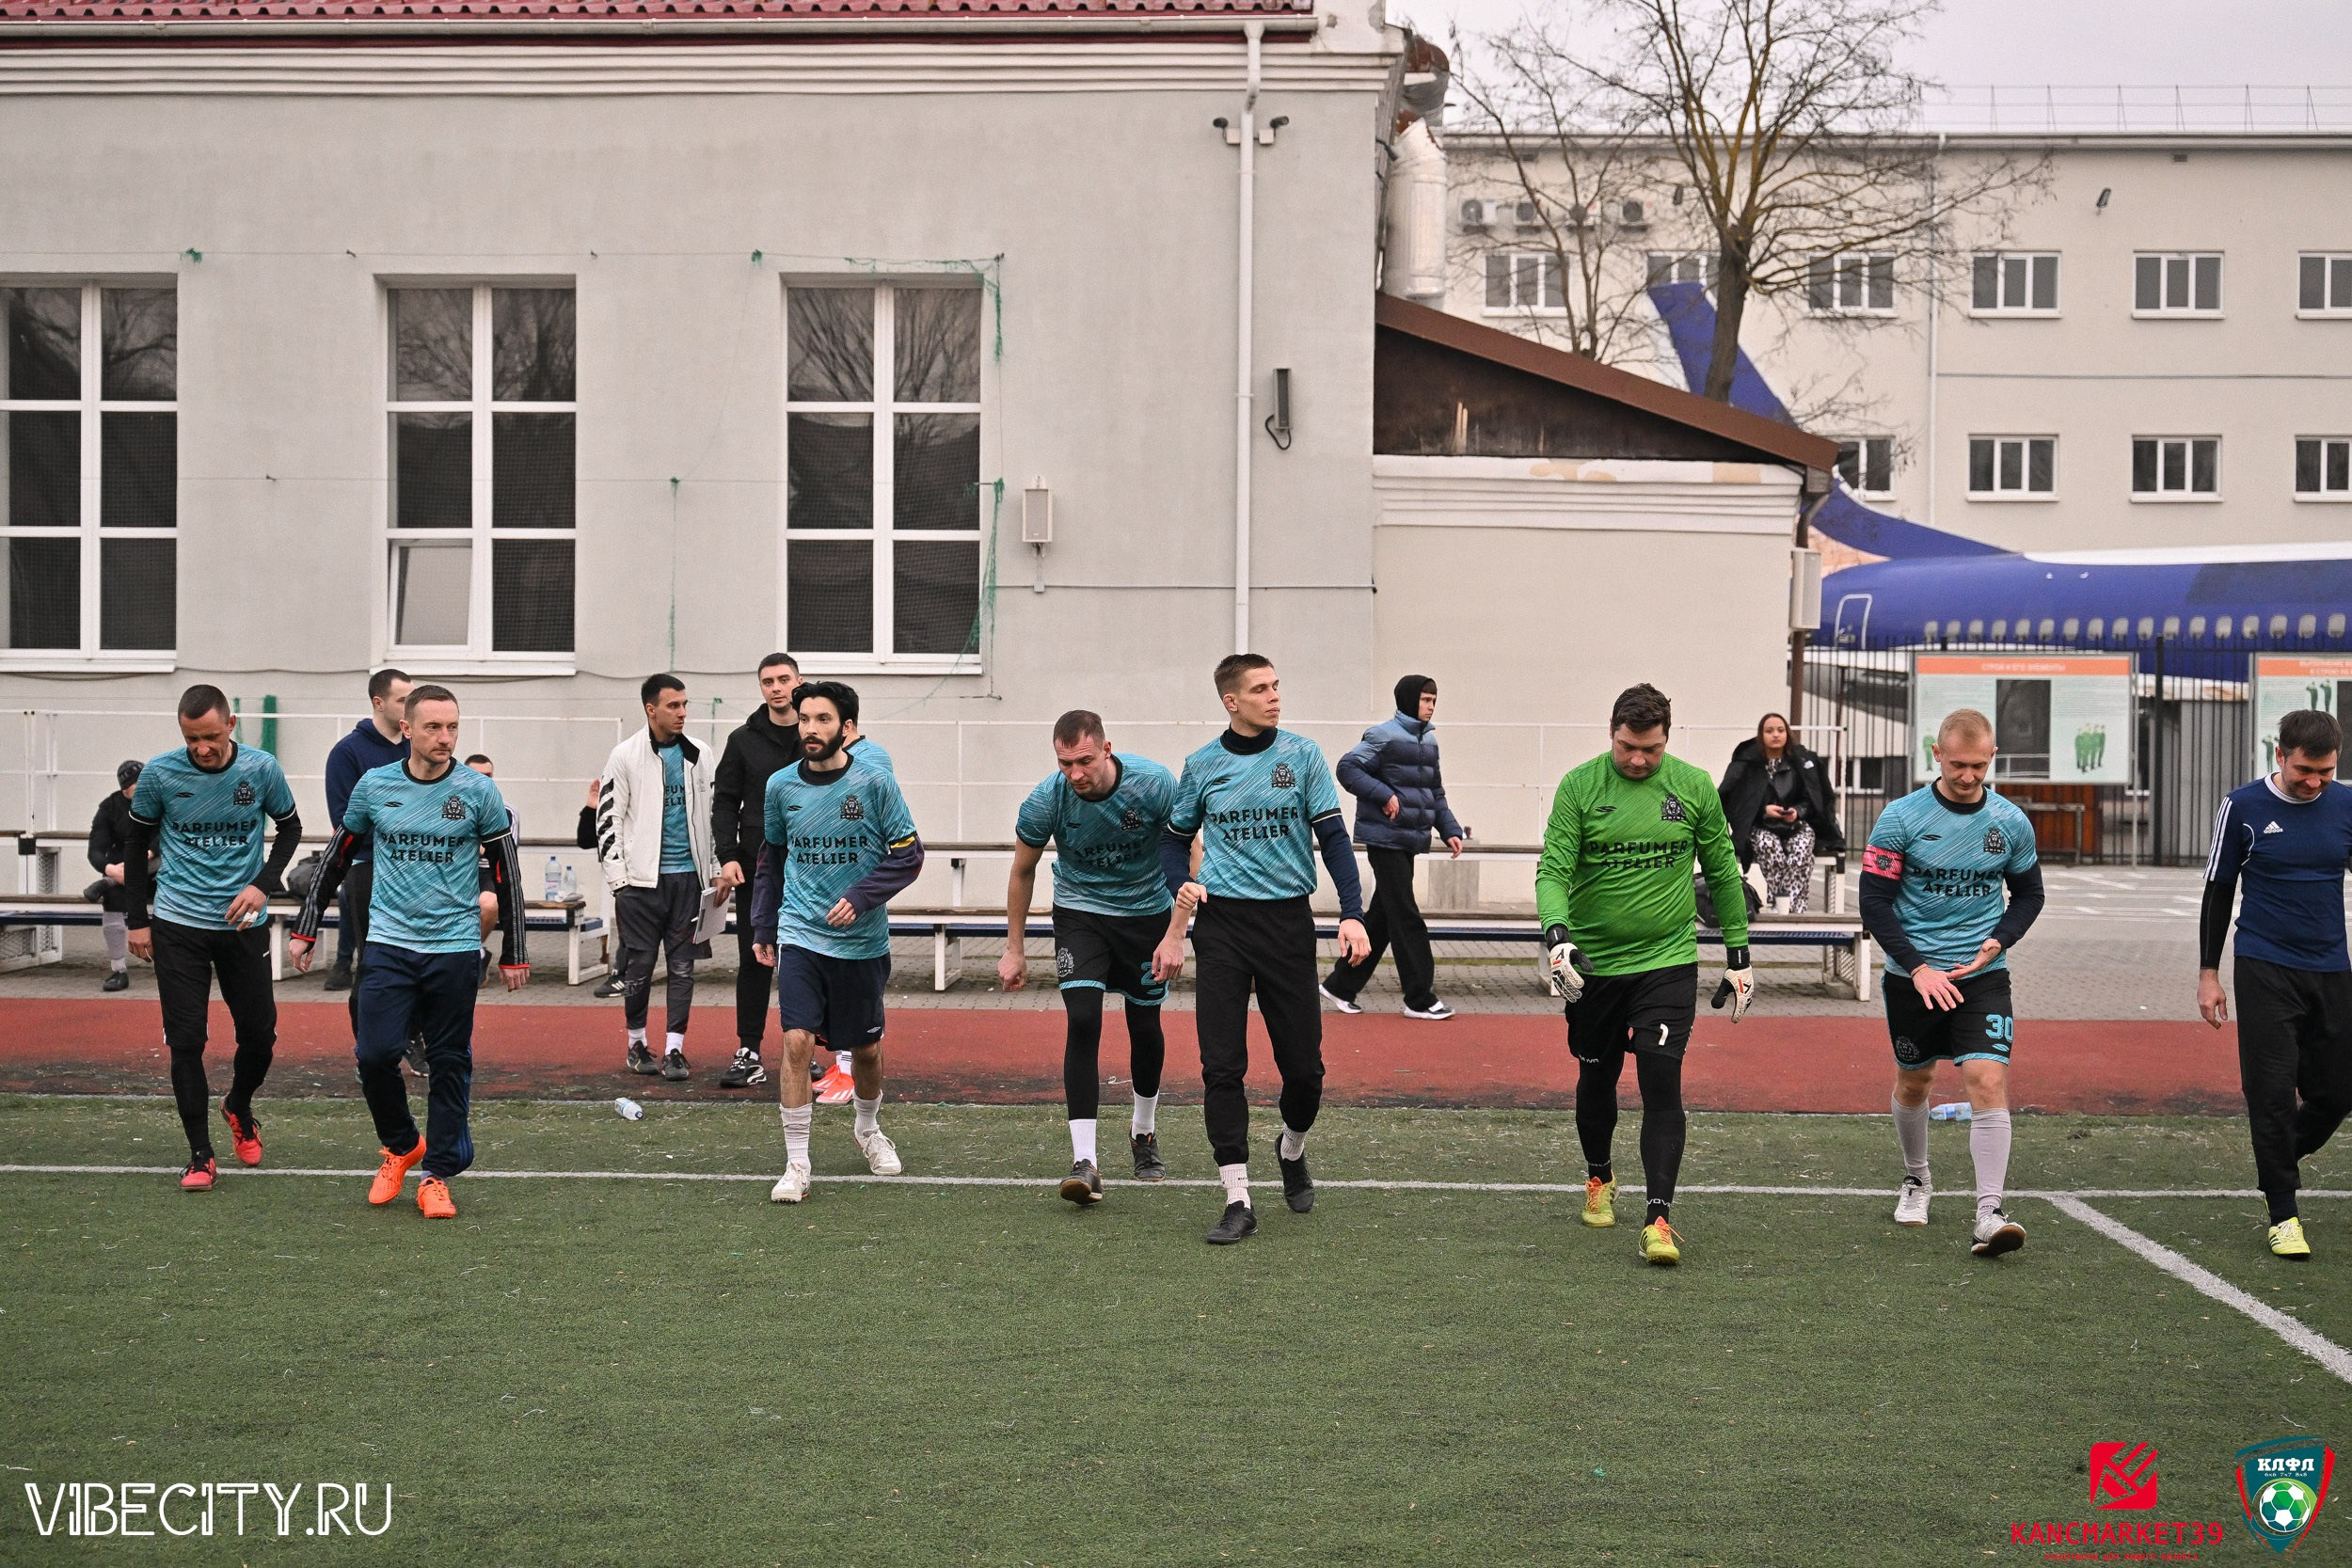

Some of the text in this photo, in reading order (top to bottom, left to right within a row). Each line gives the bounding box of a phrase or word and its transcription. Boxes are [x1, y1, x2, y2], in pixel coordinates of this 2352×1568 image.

[1210, 807, 1298, 824] PARFUMER
[381, 832, 466, 847] PARFUMER
[1223, 825, 1290, 841] ATELIER
[1589, 840, 1688, 854] PARFUMER
[389, 849, 453, 863] ATELIER
[797, 852, 858, 864] ATELIER
[1601, 854, 1675, 868] ATELIER
[1922, 881, 1991, 896] ATELIER
[1985, 1014, 2013, 1042] 30
